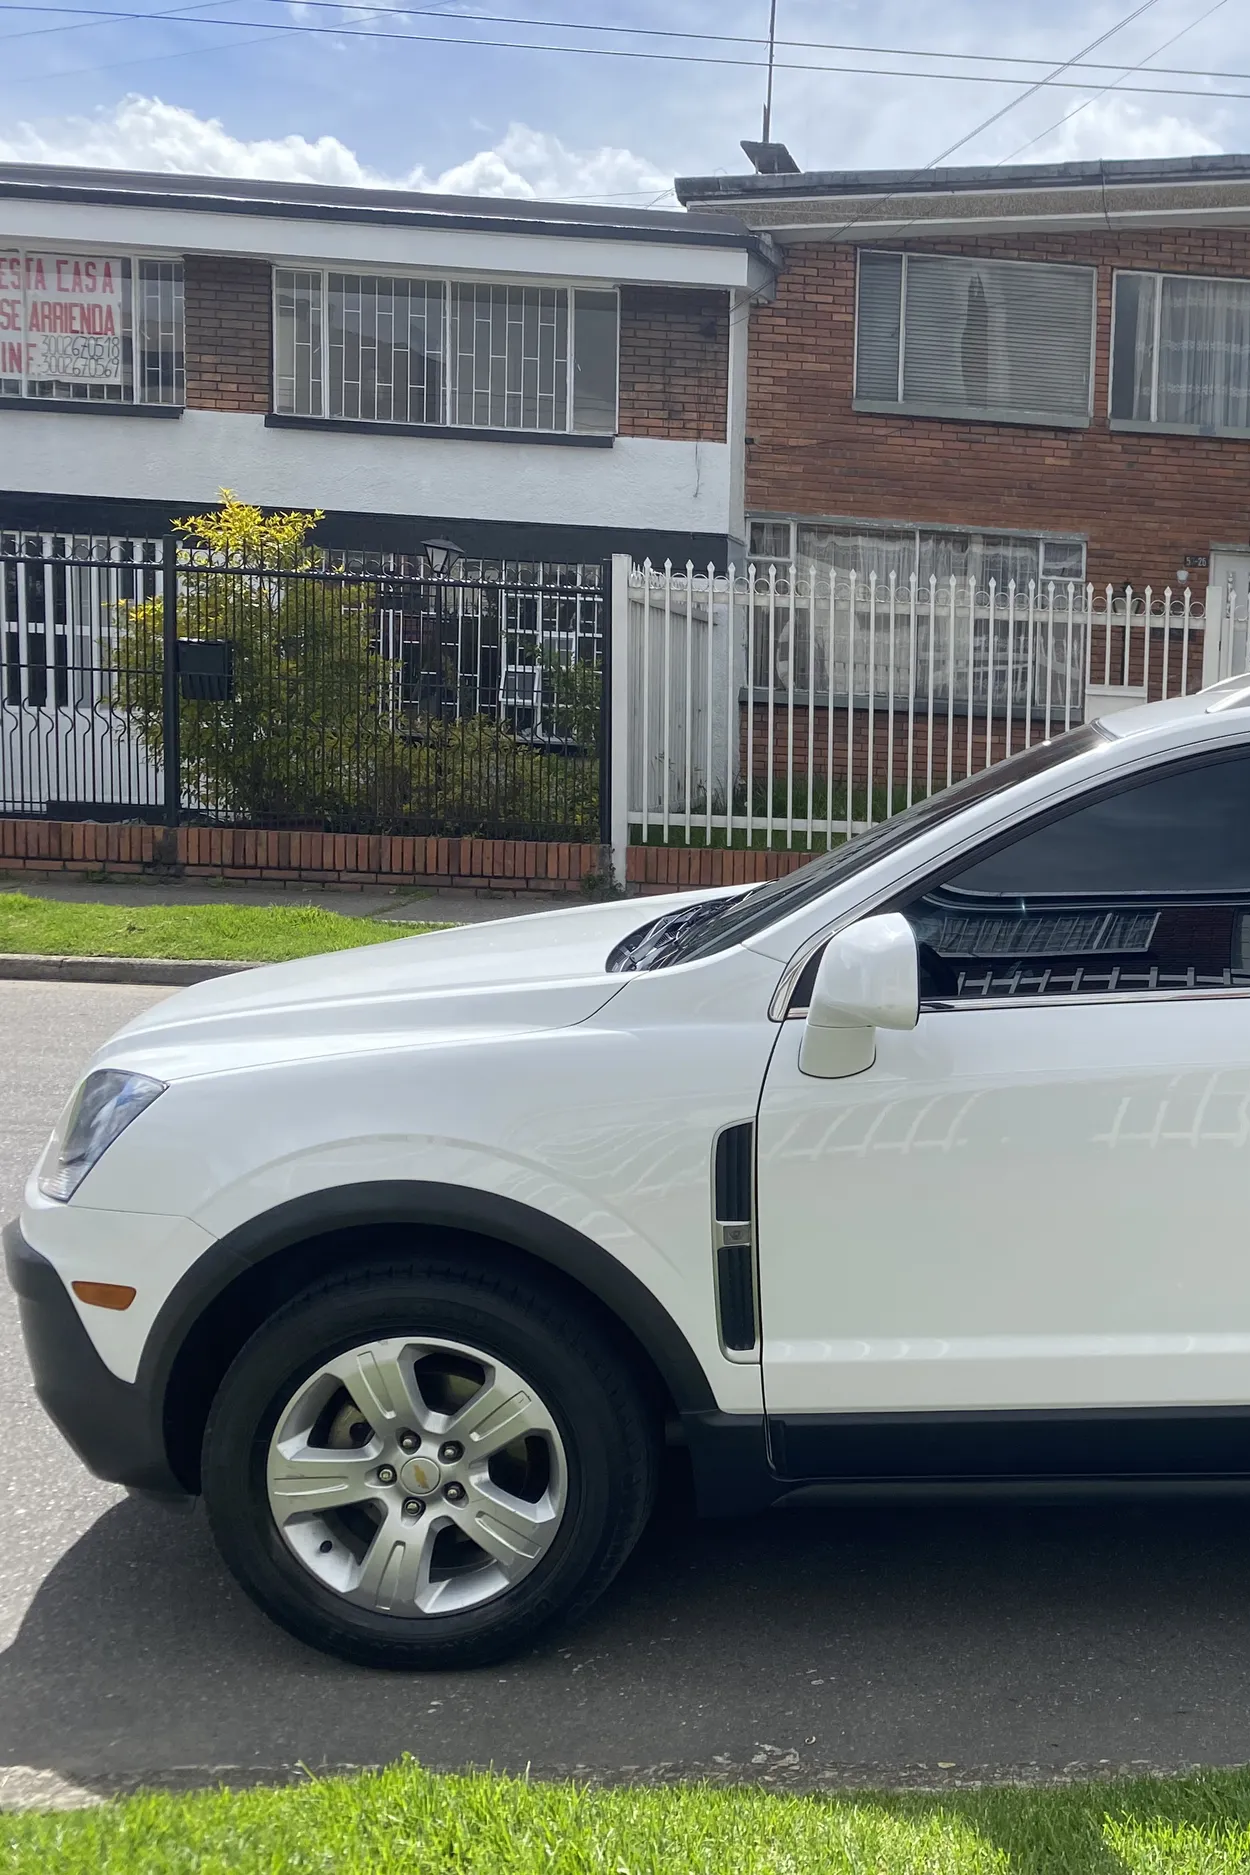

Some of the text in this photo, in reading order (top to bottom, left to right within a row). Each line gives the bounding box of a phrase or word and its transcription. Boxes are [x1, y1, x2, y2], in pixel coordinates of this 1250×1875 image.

[0, 257, 115, 294] ESTA CASA
[0, 298, 115, 336] SE ARRIENDA
[1185, 556, 1207, 567] 5-26
